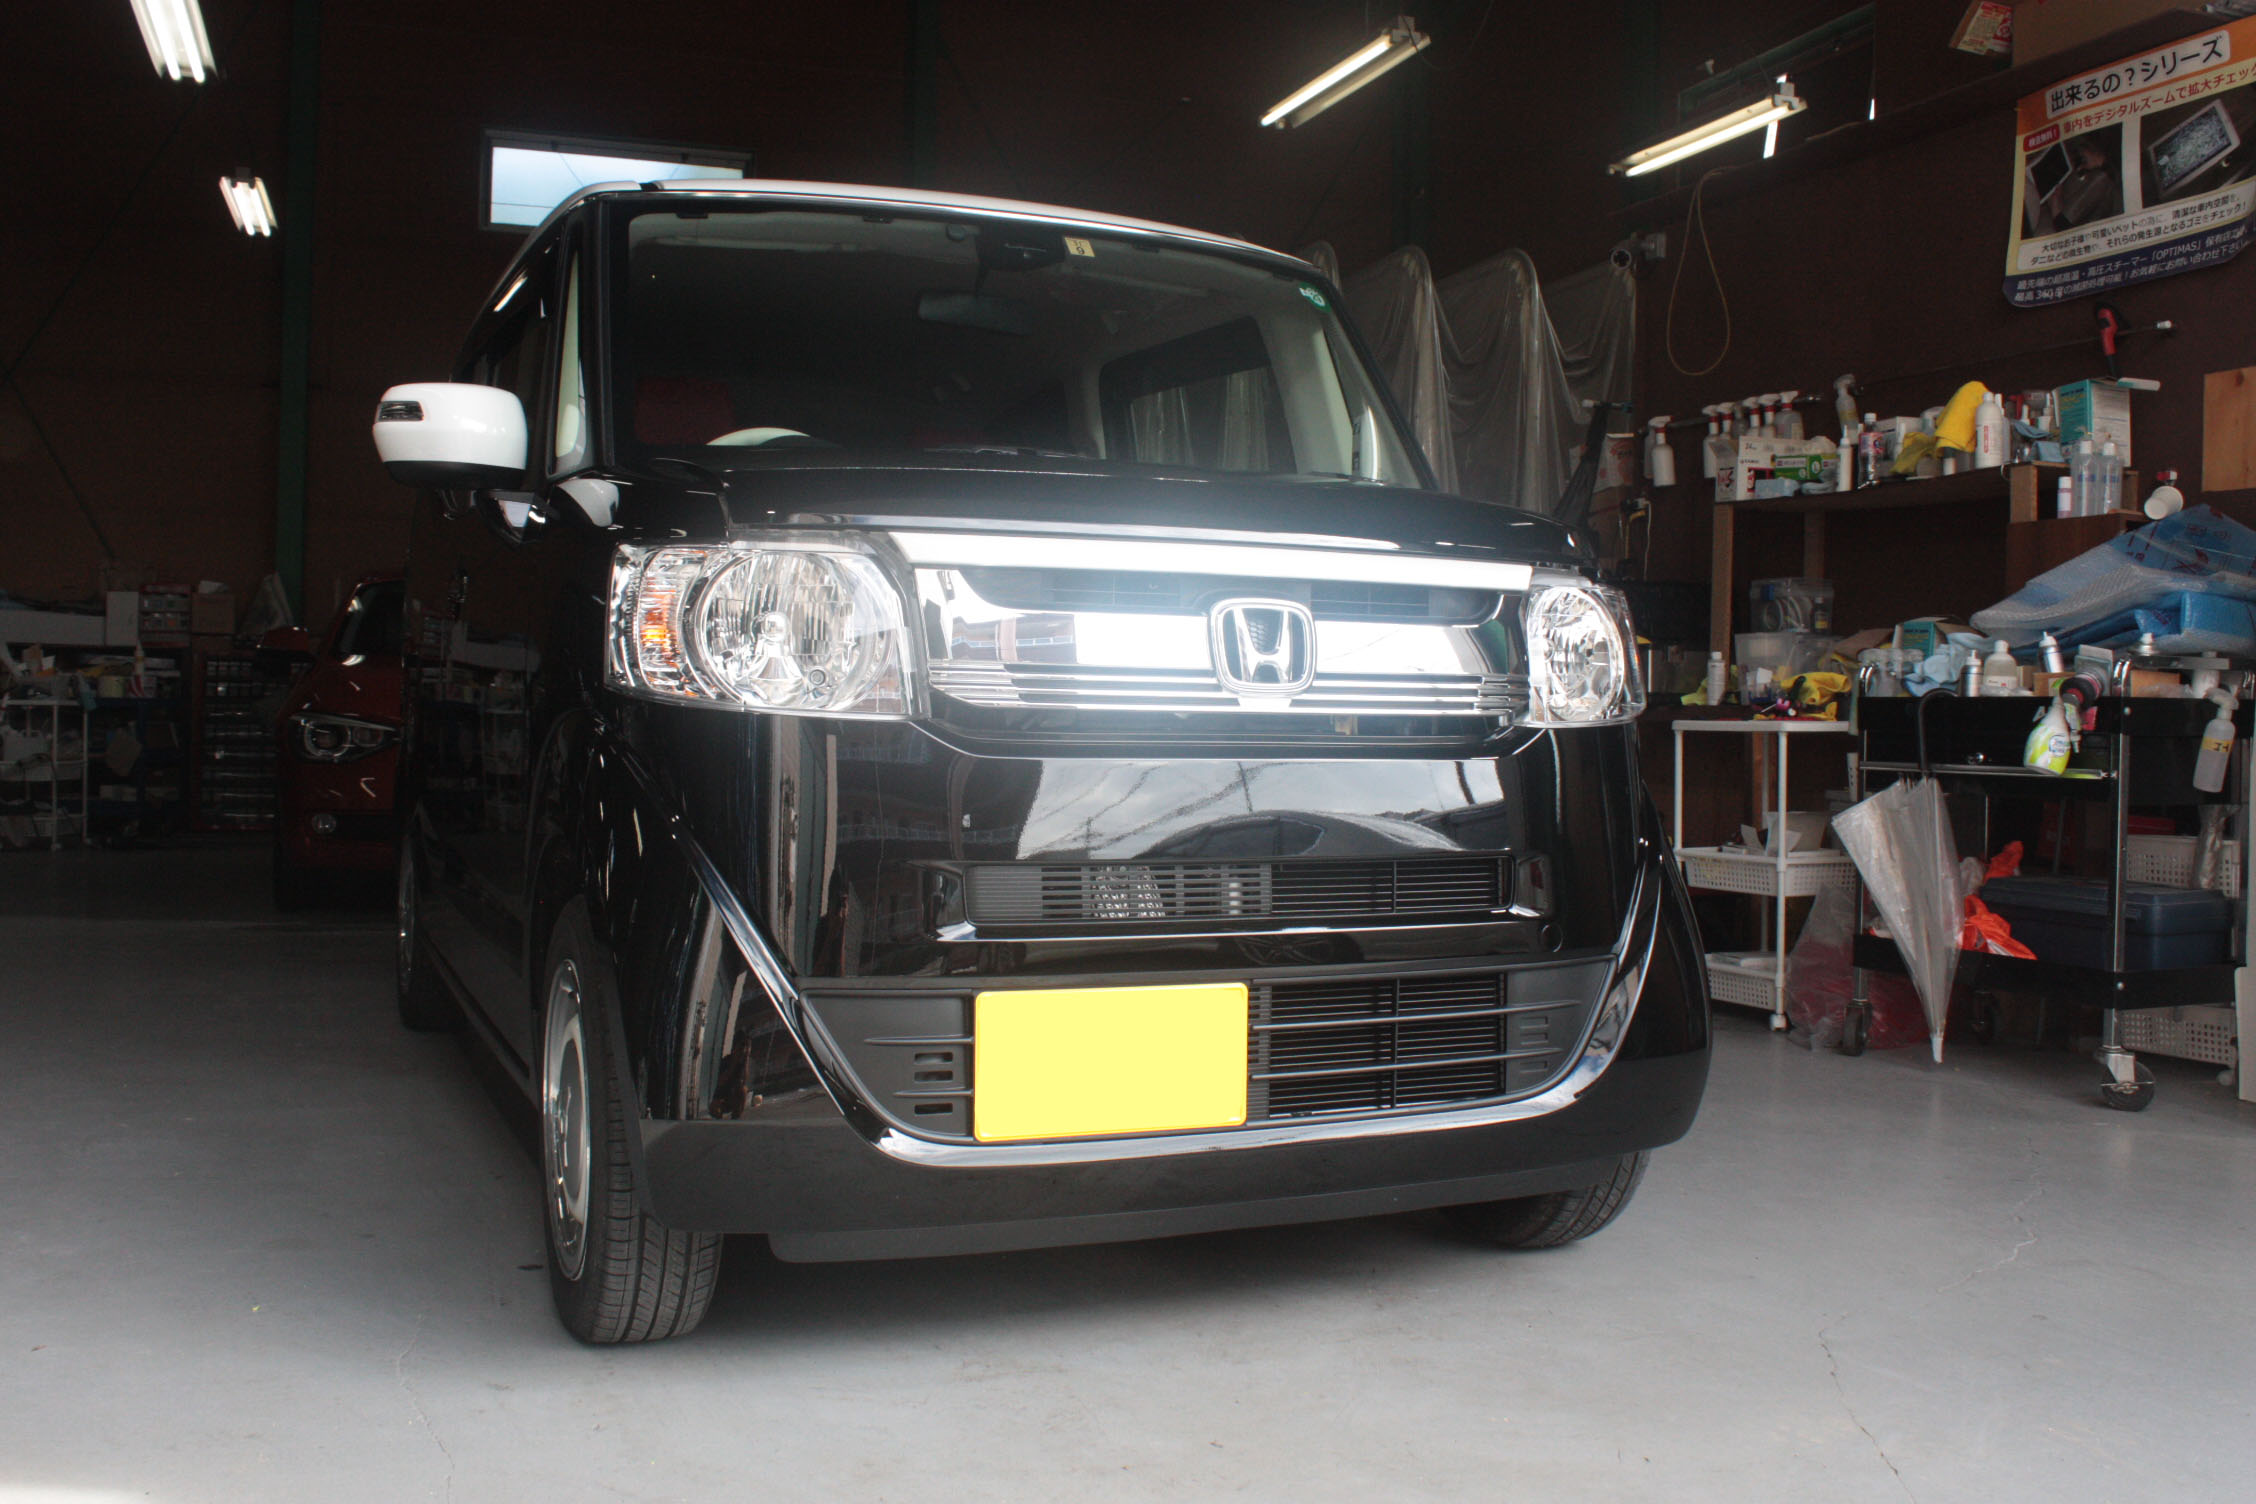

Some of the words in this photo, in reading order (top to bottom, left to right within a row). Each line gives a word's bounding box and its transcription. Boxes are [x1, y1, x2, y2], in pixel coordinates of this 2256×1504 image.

[2051, 35, 2223, 113] 出来るの？シリーズ
